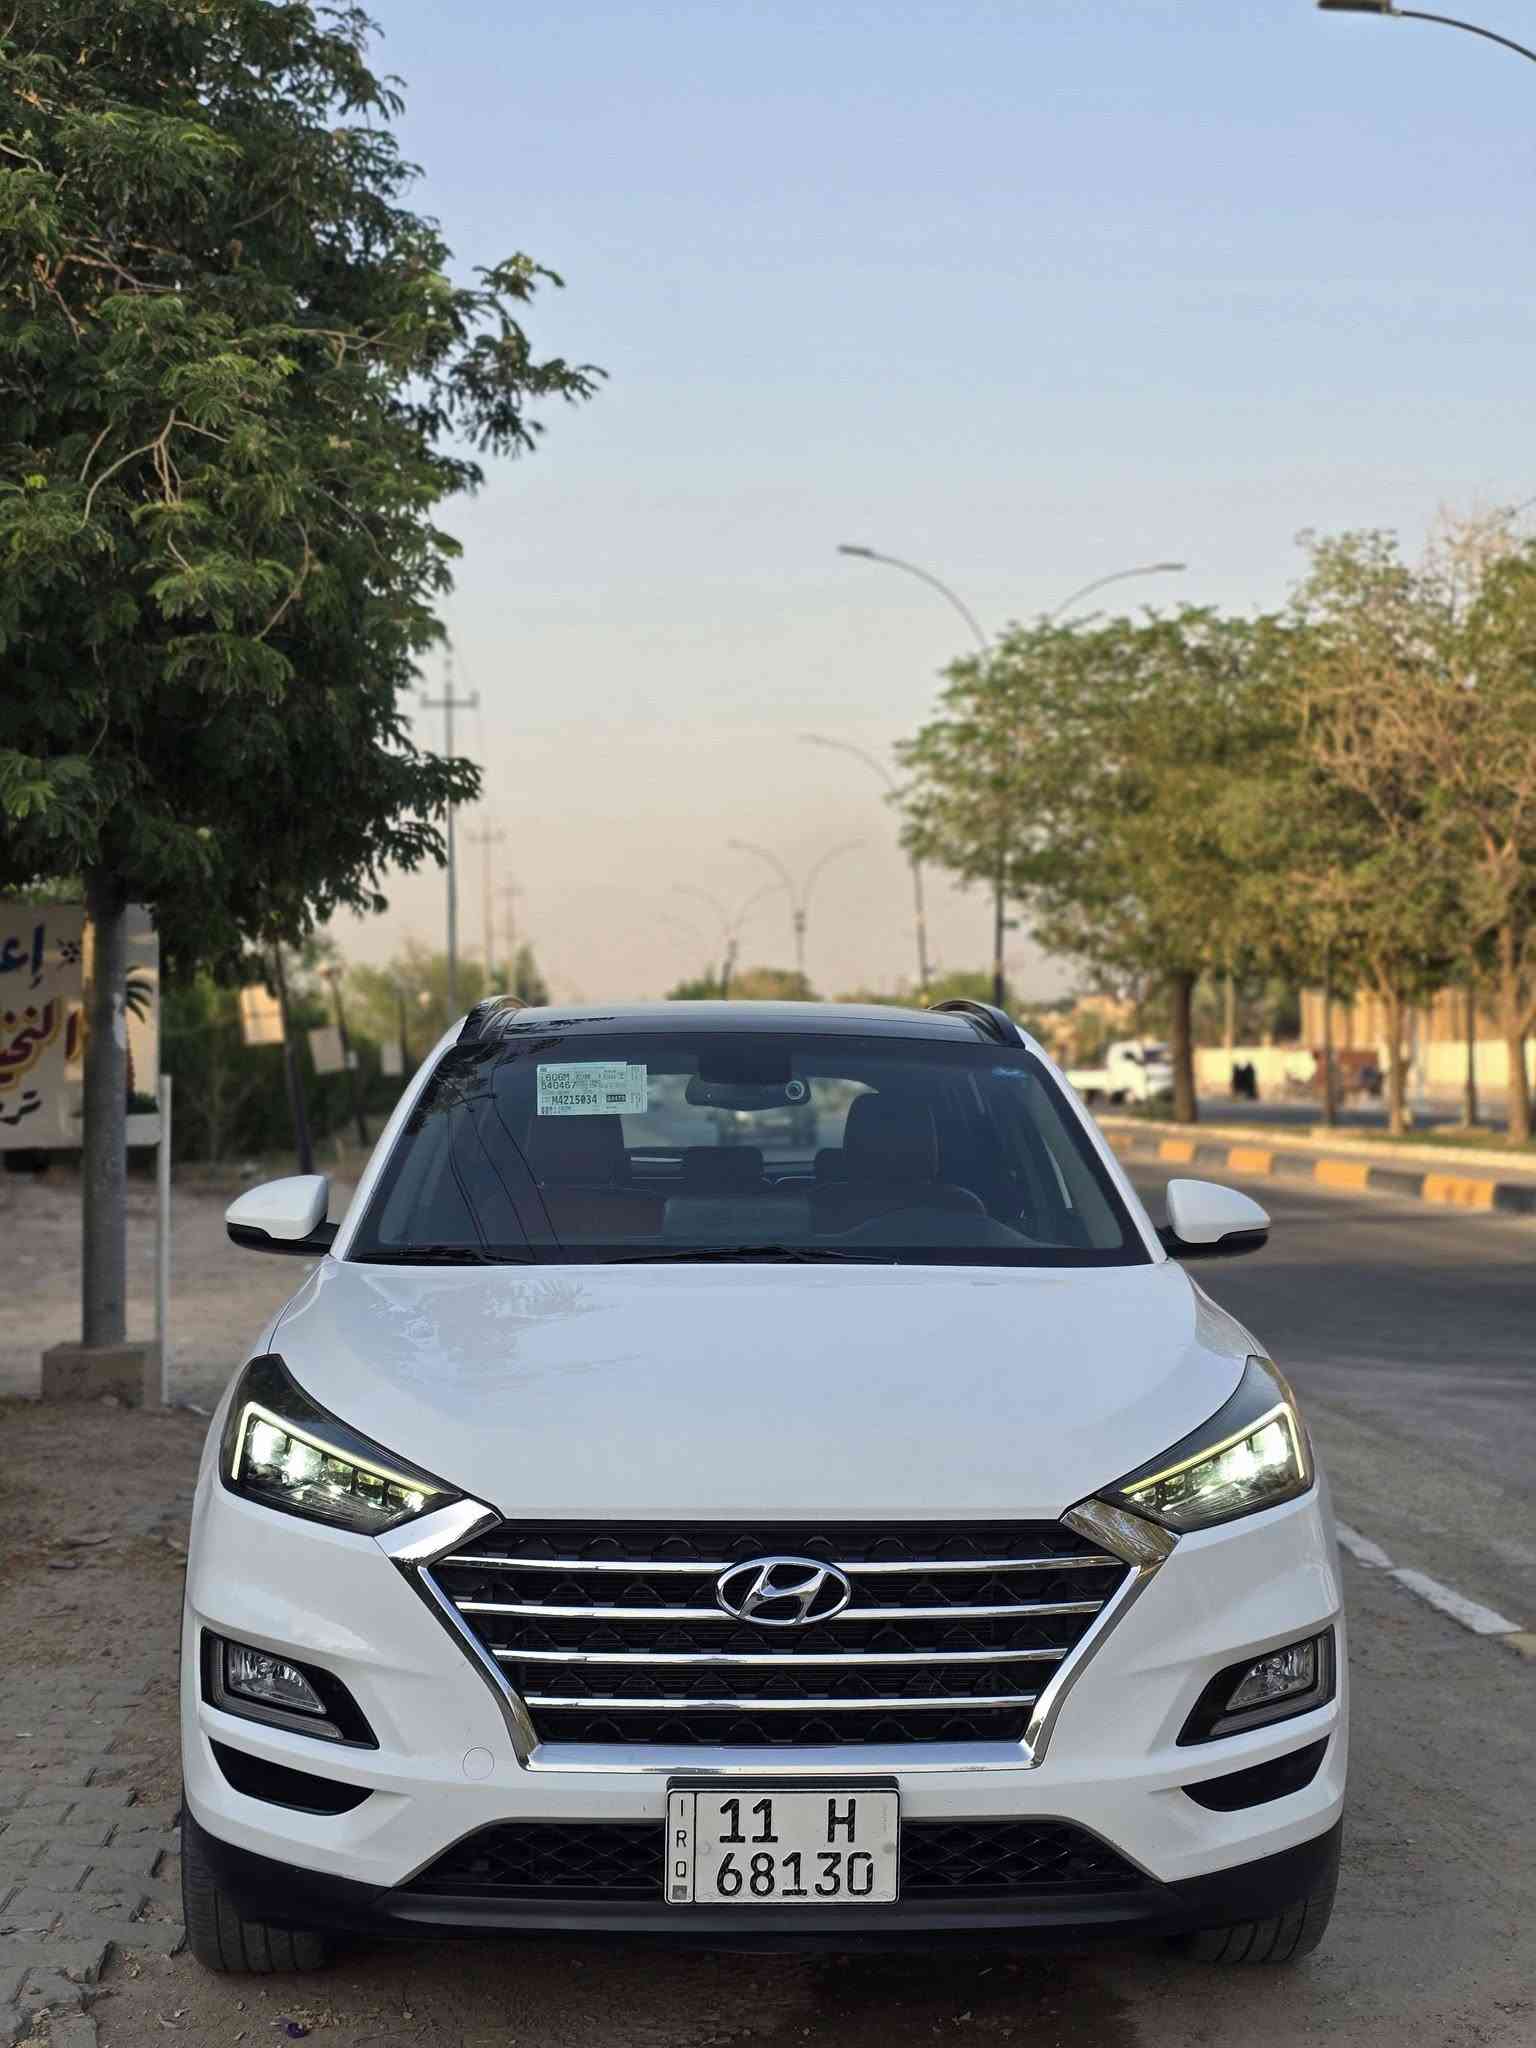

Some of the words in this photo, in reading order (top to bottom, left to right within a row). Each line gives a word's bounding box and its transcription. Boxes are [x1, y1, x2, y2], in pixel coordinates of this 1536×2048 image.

[0, 924, 45, 989] إع
[719, 1798, 779, 1843] 11
[827, 1798, 857, 1843] H
[716, 1851, 874, 1897] 68130
